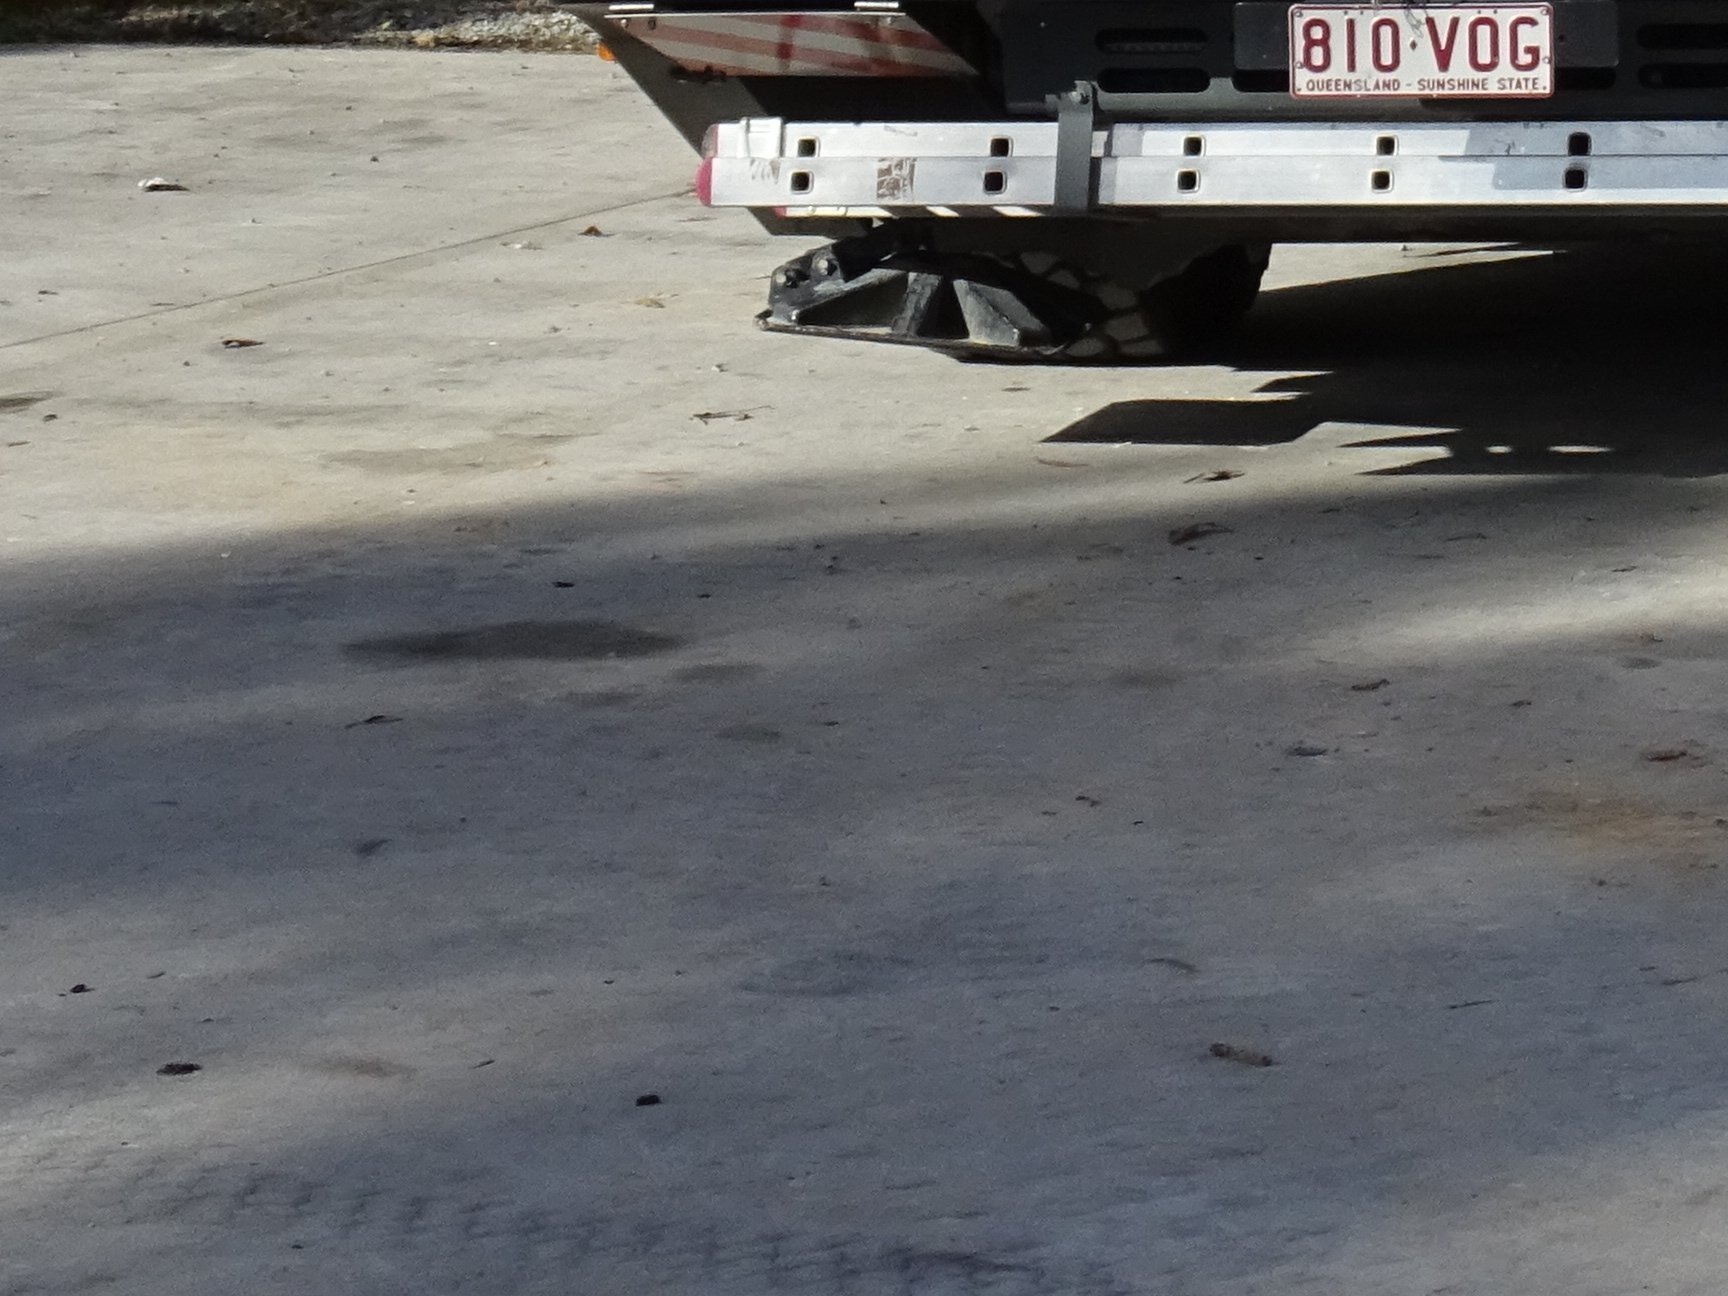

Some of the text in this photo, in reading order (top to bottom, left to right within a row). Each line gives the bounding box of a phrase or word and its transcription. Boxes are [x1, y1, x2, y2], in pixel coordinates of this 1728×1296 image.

[1302, 16, 1541, 73] 810 VOG
[1306, 77, 1539, 92] QUEENSLAND SUNSHINE STATE
